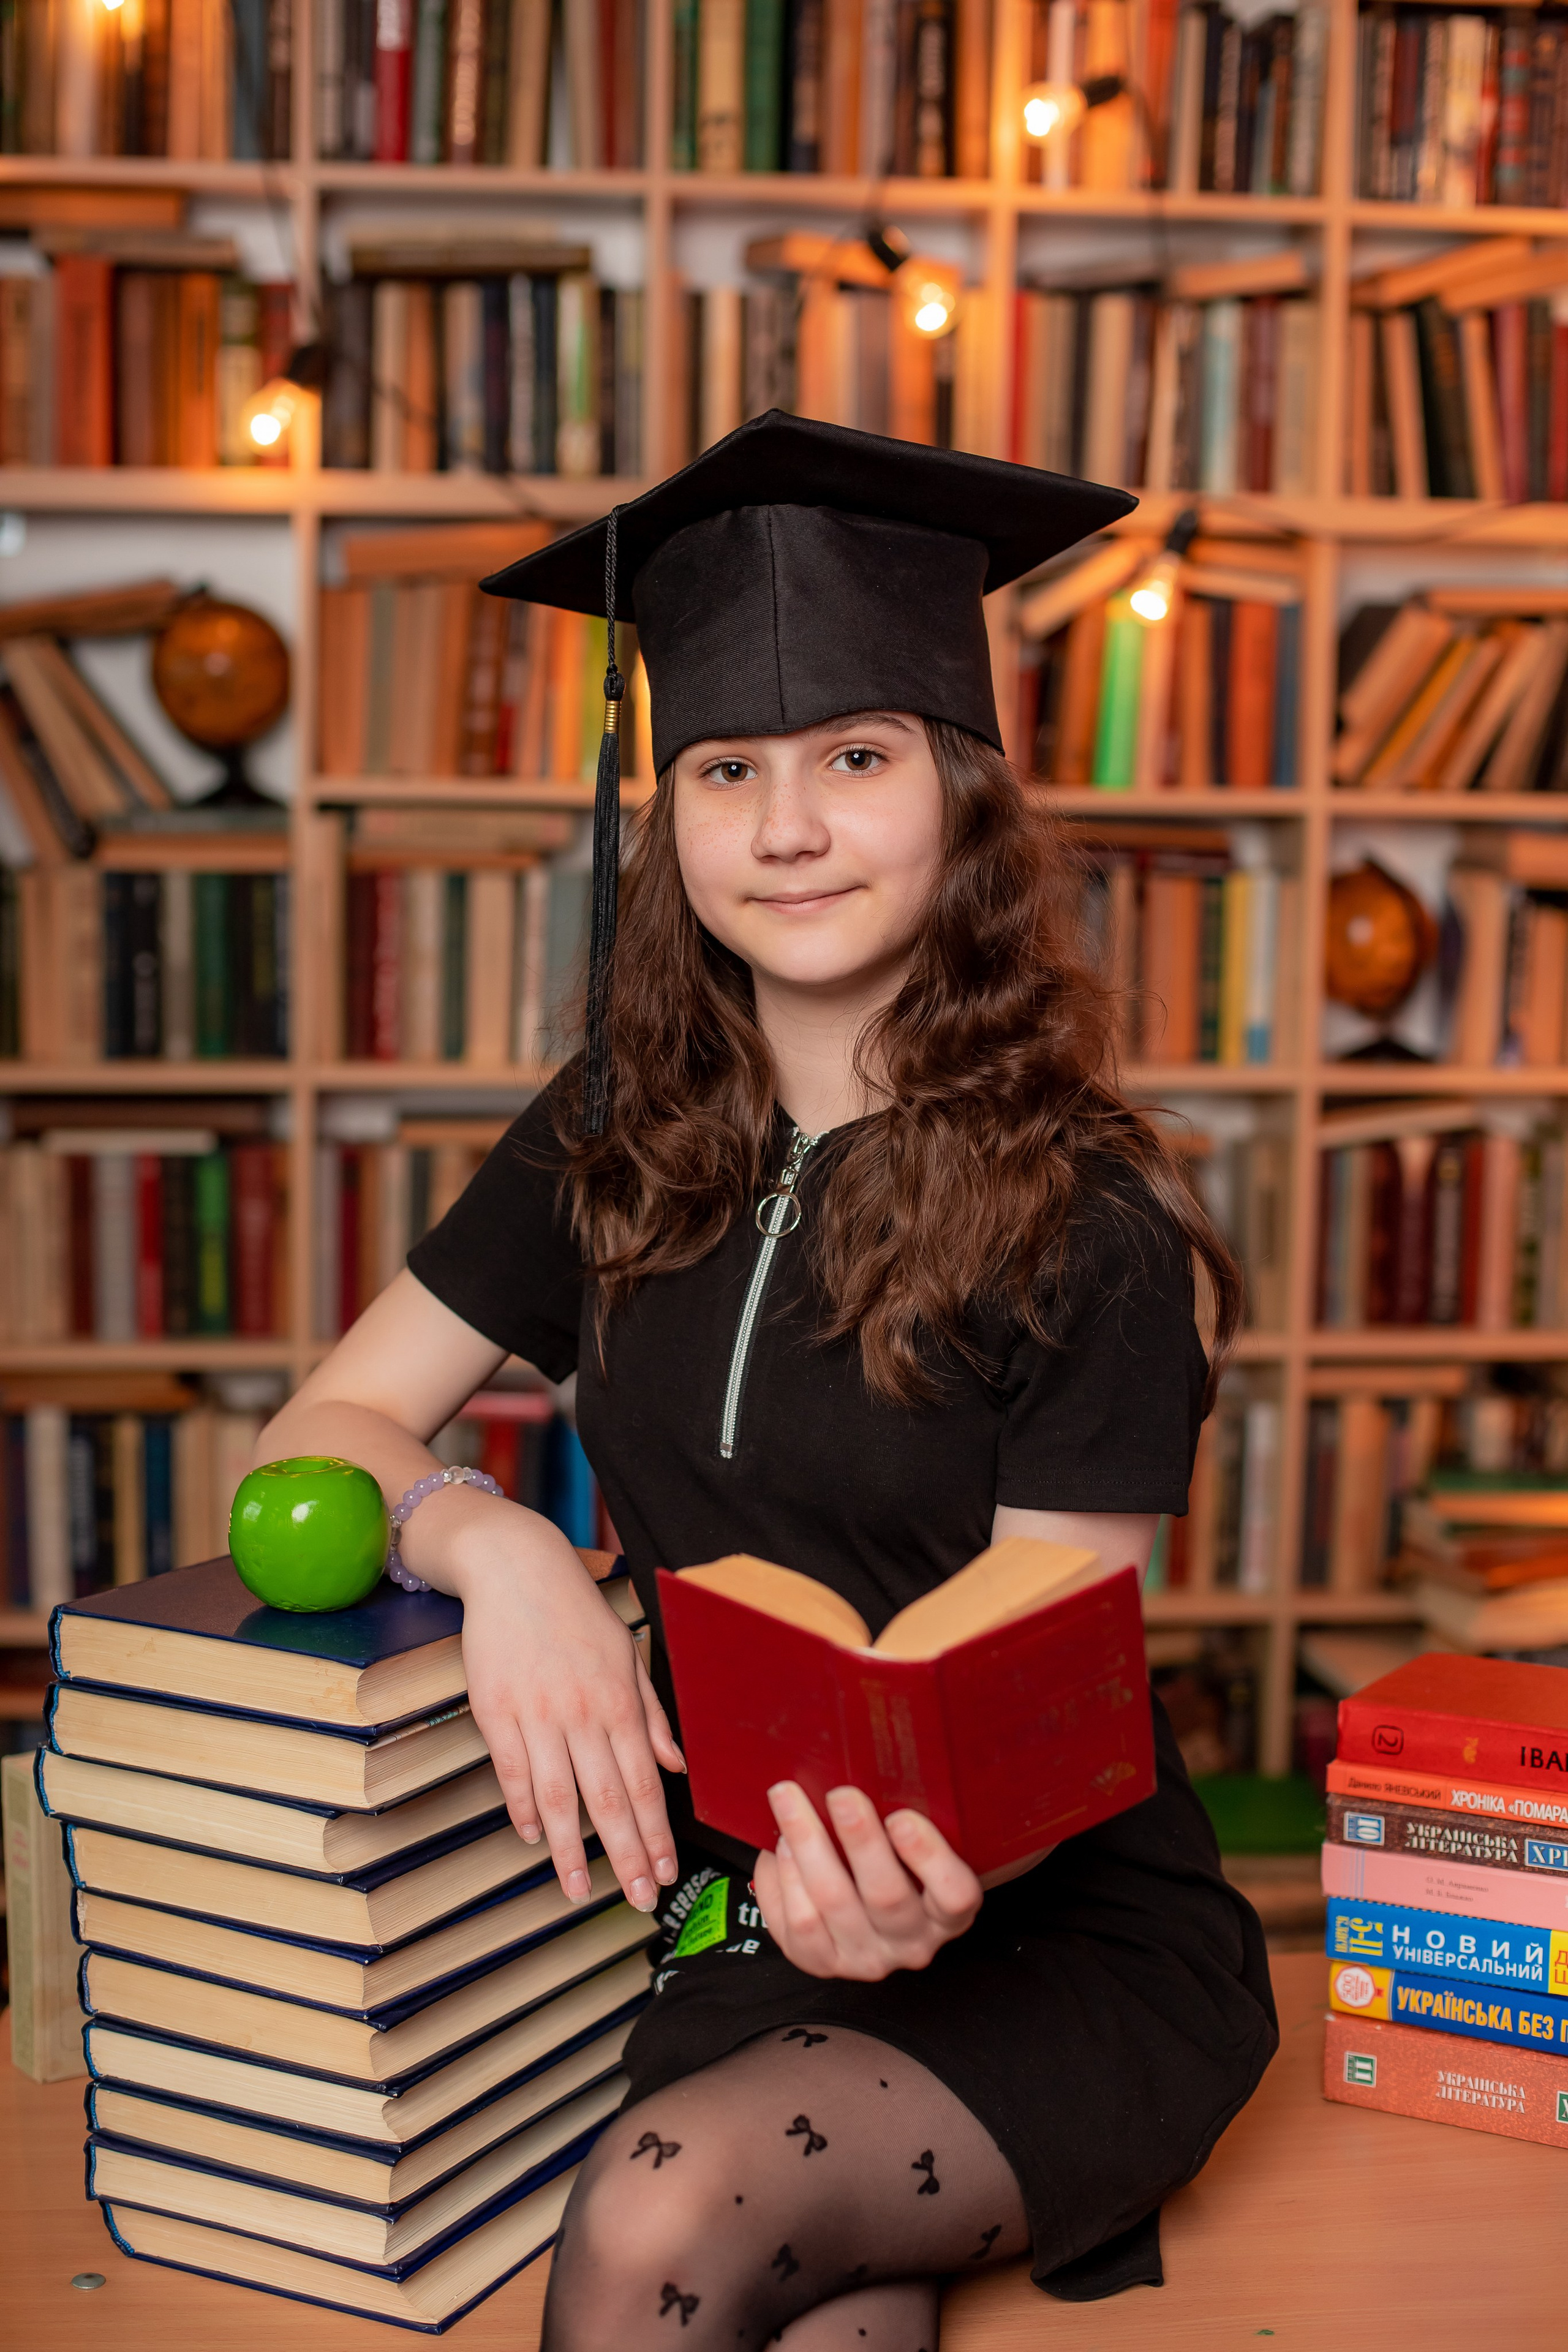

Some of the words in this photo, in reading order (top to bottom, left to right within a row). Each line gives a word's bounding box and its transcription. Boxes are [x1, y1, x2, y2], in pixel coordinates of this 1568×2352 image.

[1520, 1746, 1568, 1773] ІВА
[1450, 1789, 1506, 1814] ХРОНІКА
[1356, 1817, 1381, 1841] 10
[1392, 1924, 1544, 1965] НОВИЙ
[1392, 1943, 1543, 1982] УНІВЕРСАЛЬНИЙ
[1396, 1986, 1513, 2032] УКРАЇНСЬКА
[1518, 2010, 1555, 2041] БЕЗ
